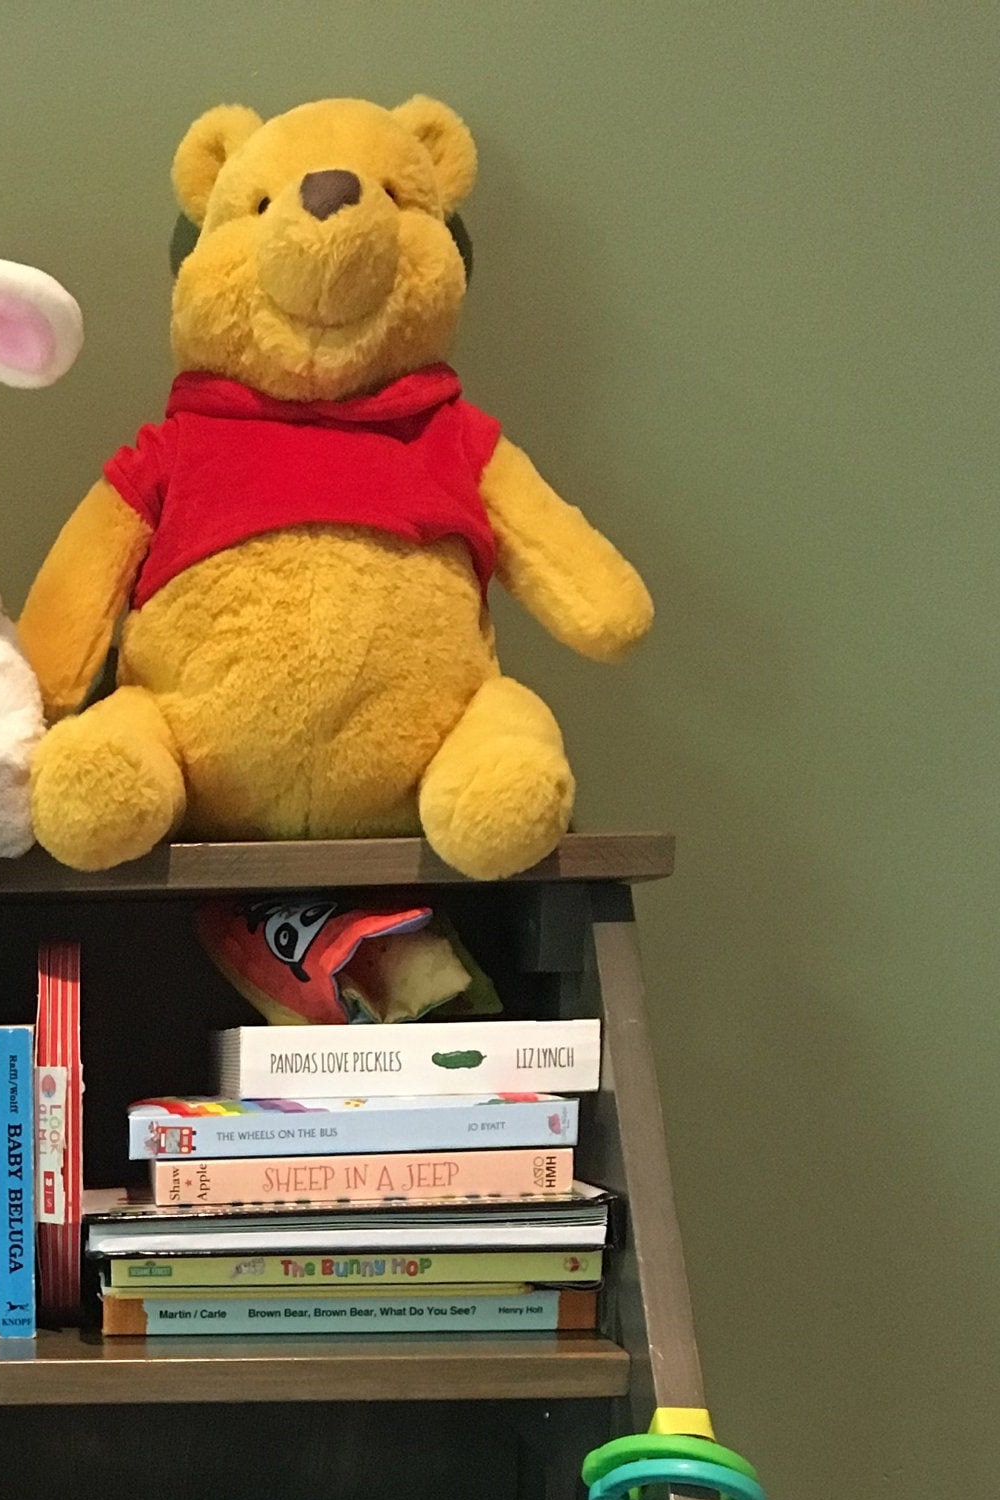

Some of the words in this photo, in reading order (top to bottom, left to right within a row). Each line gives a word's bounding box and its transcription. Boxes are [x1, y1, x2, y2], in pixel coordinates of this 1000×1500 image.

[270, 1052, 319, 1074] PANDAS
[321, 1052, 351, 1074] LOVE
[353, 1050, 403, 1073] PICKLES
[516, 1048, 534, 1069] LIZ
[537, 1047, 575, 1068] LYNCH
[49, 1104, 62, 1154] LOOK
[216, 1131, 235, 1141] THE
[237, 1129, 275, 1140] WHEELS
[278, 1129, 295, 1139] ON
[298, 1128, 316, 1138] THE
[319, 1127, 338, 1137] BUS
[7, 1123, 23, 1181] BABY
[169, 1166, 180, 1201] Shaw
[196, 1163, 211, 1201] Apple
[262, 1165, 335, 1192] SHEEP
[345, 1164, 369, 1190] IN
[376, 1165, 394, 1191] A
[401, 1162, 460, 1191] JEEP
[546, 1155, 557, 1188] HMH
[8, 1188, 24, 1274] BELUGA
[281, 1259, 316, 1278] The
[321, 1258, 386, 1278] Bunny
[1, 1318, 32, 1326] KNOPF
[159, 1309, 191, 1319] Martin
[200, 1309, 227, 1319] Carle
[248, 1308, 281, 1318] Brown
[284, 1308, 311, 1319] Bear,
[314, 1308, 347, 1317] Brown
[350, 1307, 377, 1318] Bear,
[379, 1306, 407, 1317] What
[409, 1307, 424, 1316] Do
[427, 1306, 448, 1316] You
[450, 1306, 477, 1316] See?
[498, 1307, 524, 1317] Henry
